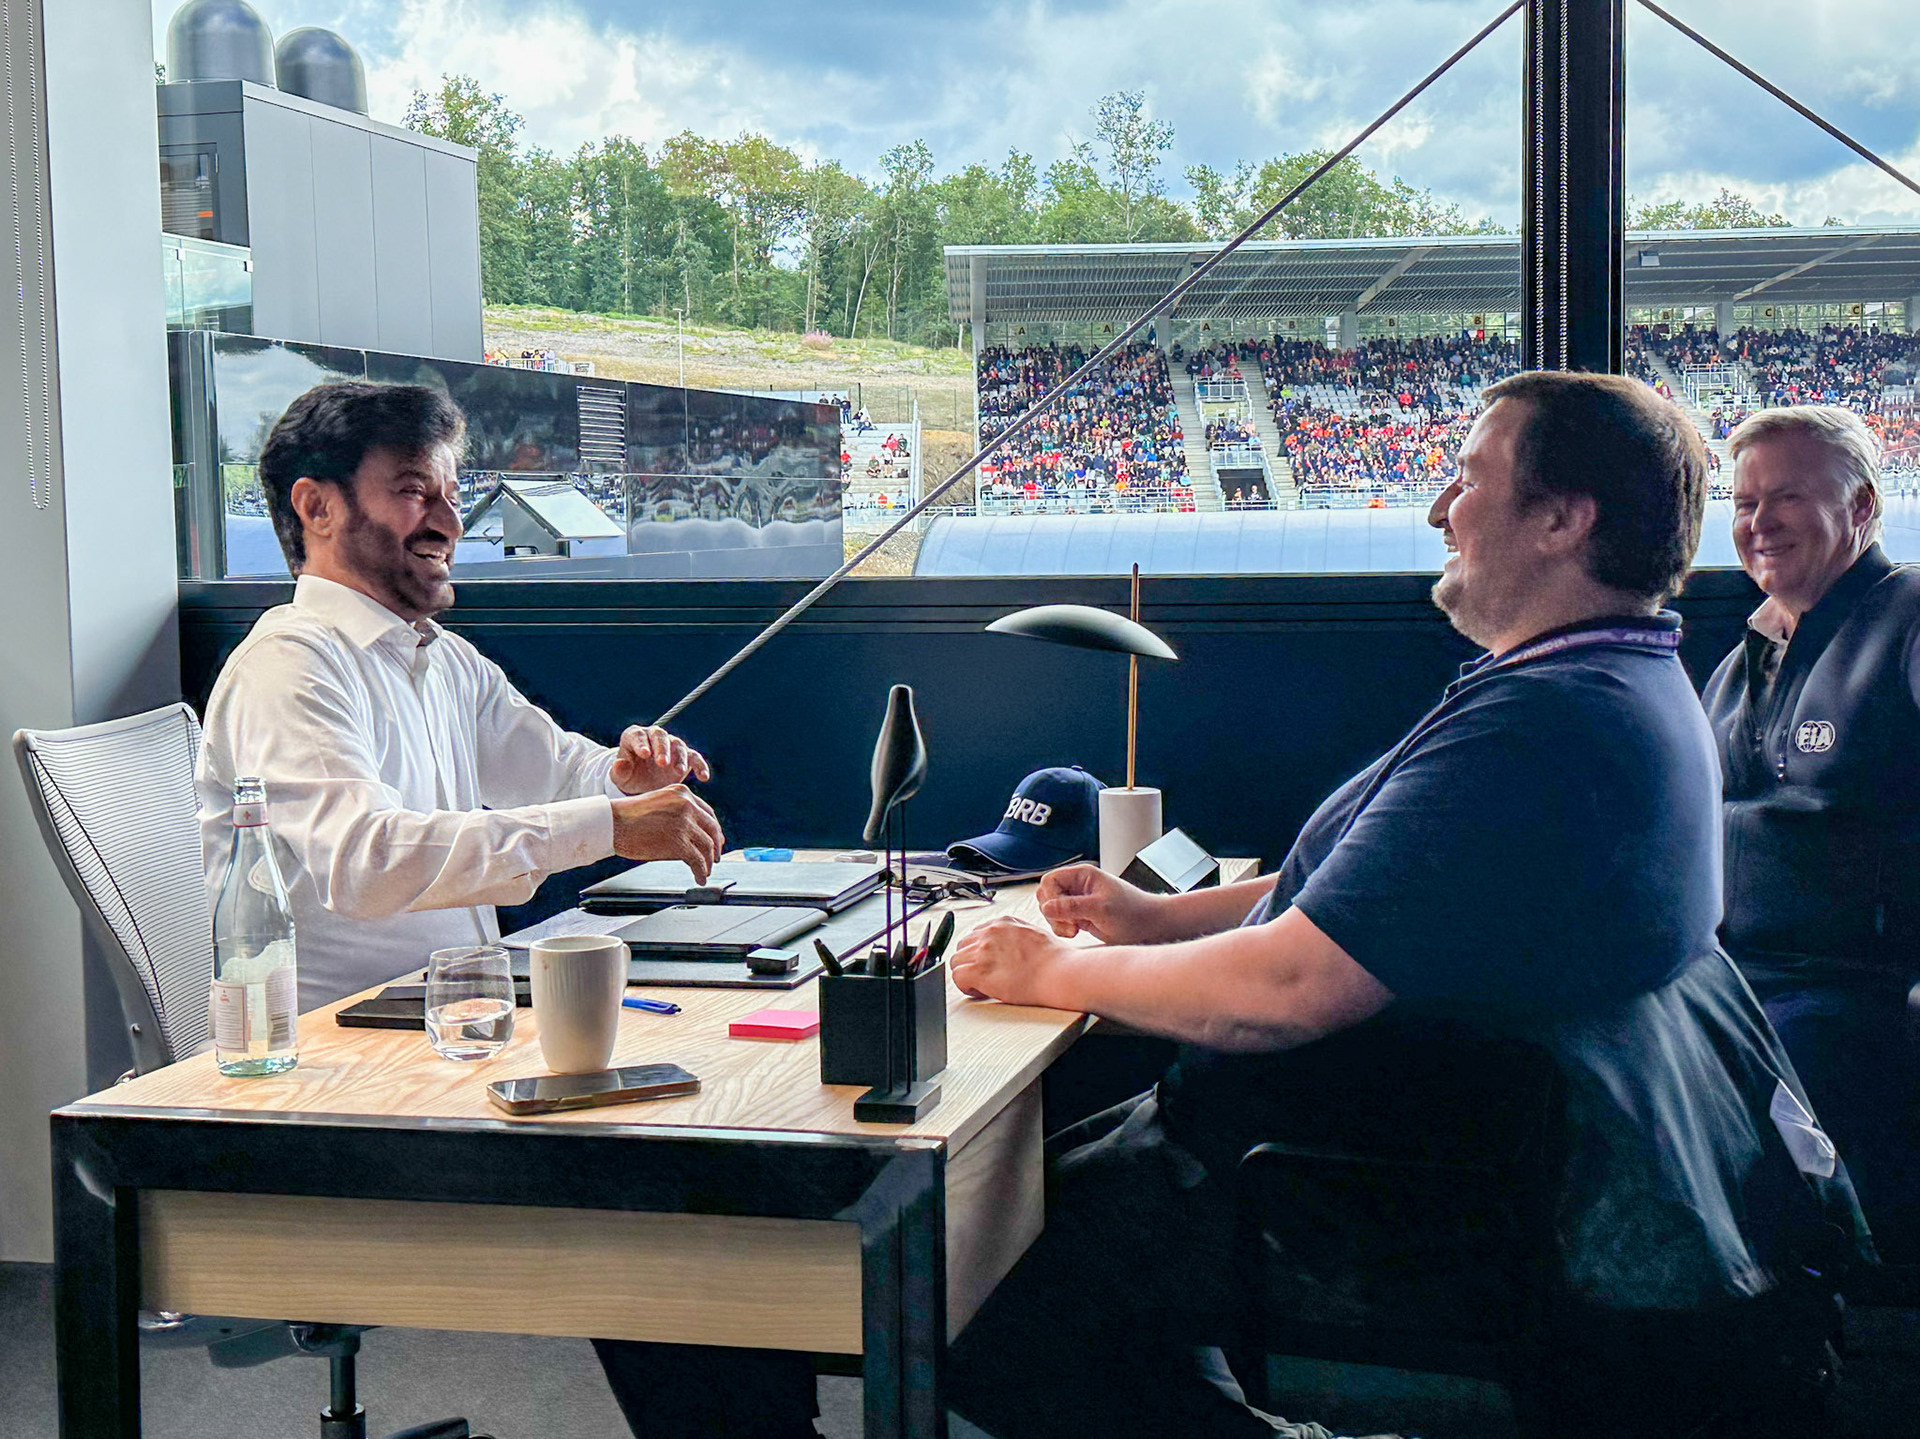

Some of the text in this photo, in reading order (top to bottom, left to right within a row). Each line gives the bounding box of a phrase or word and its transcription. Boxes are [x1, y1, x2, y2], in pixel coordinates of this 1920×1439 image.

[1765, 308, 1773, 317] C
[1852, 305, 1860, 314] C
[1662, 311, 1671, 320] B
[1017, 326, 1027, 336] A
[1102, 324, 1112, 334] A
[1797, 726, 1832, 748] FIA
